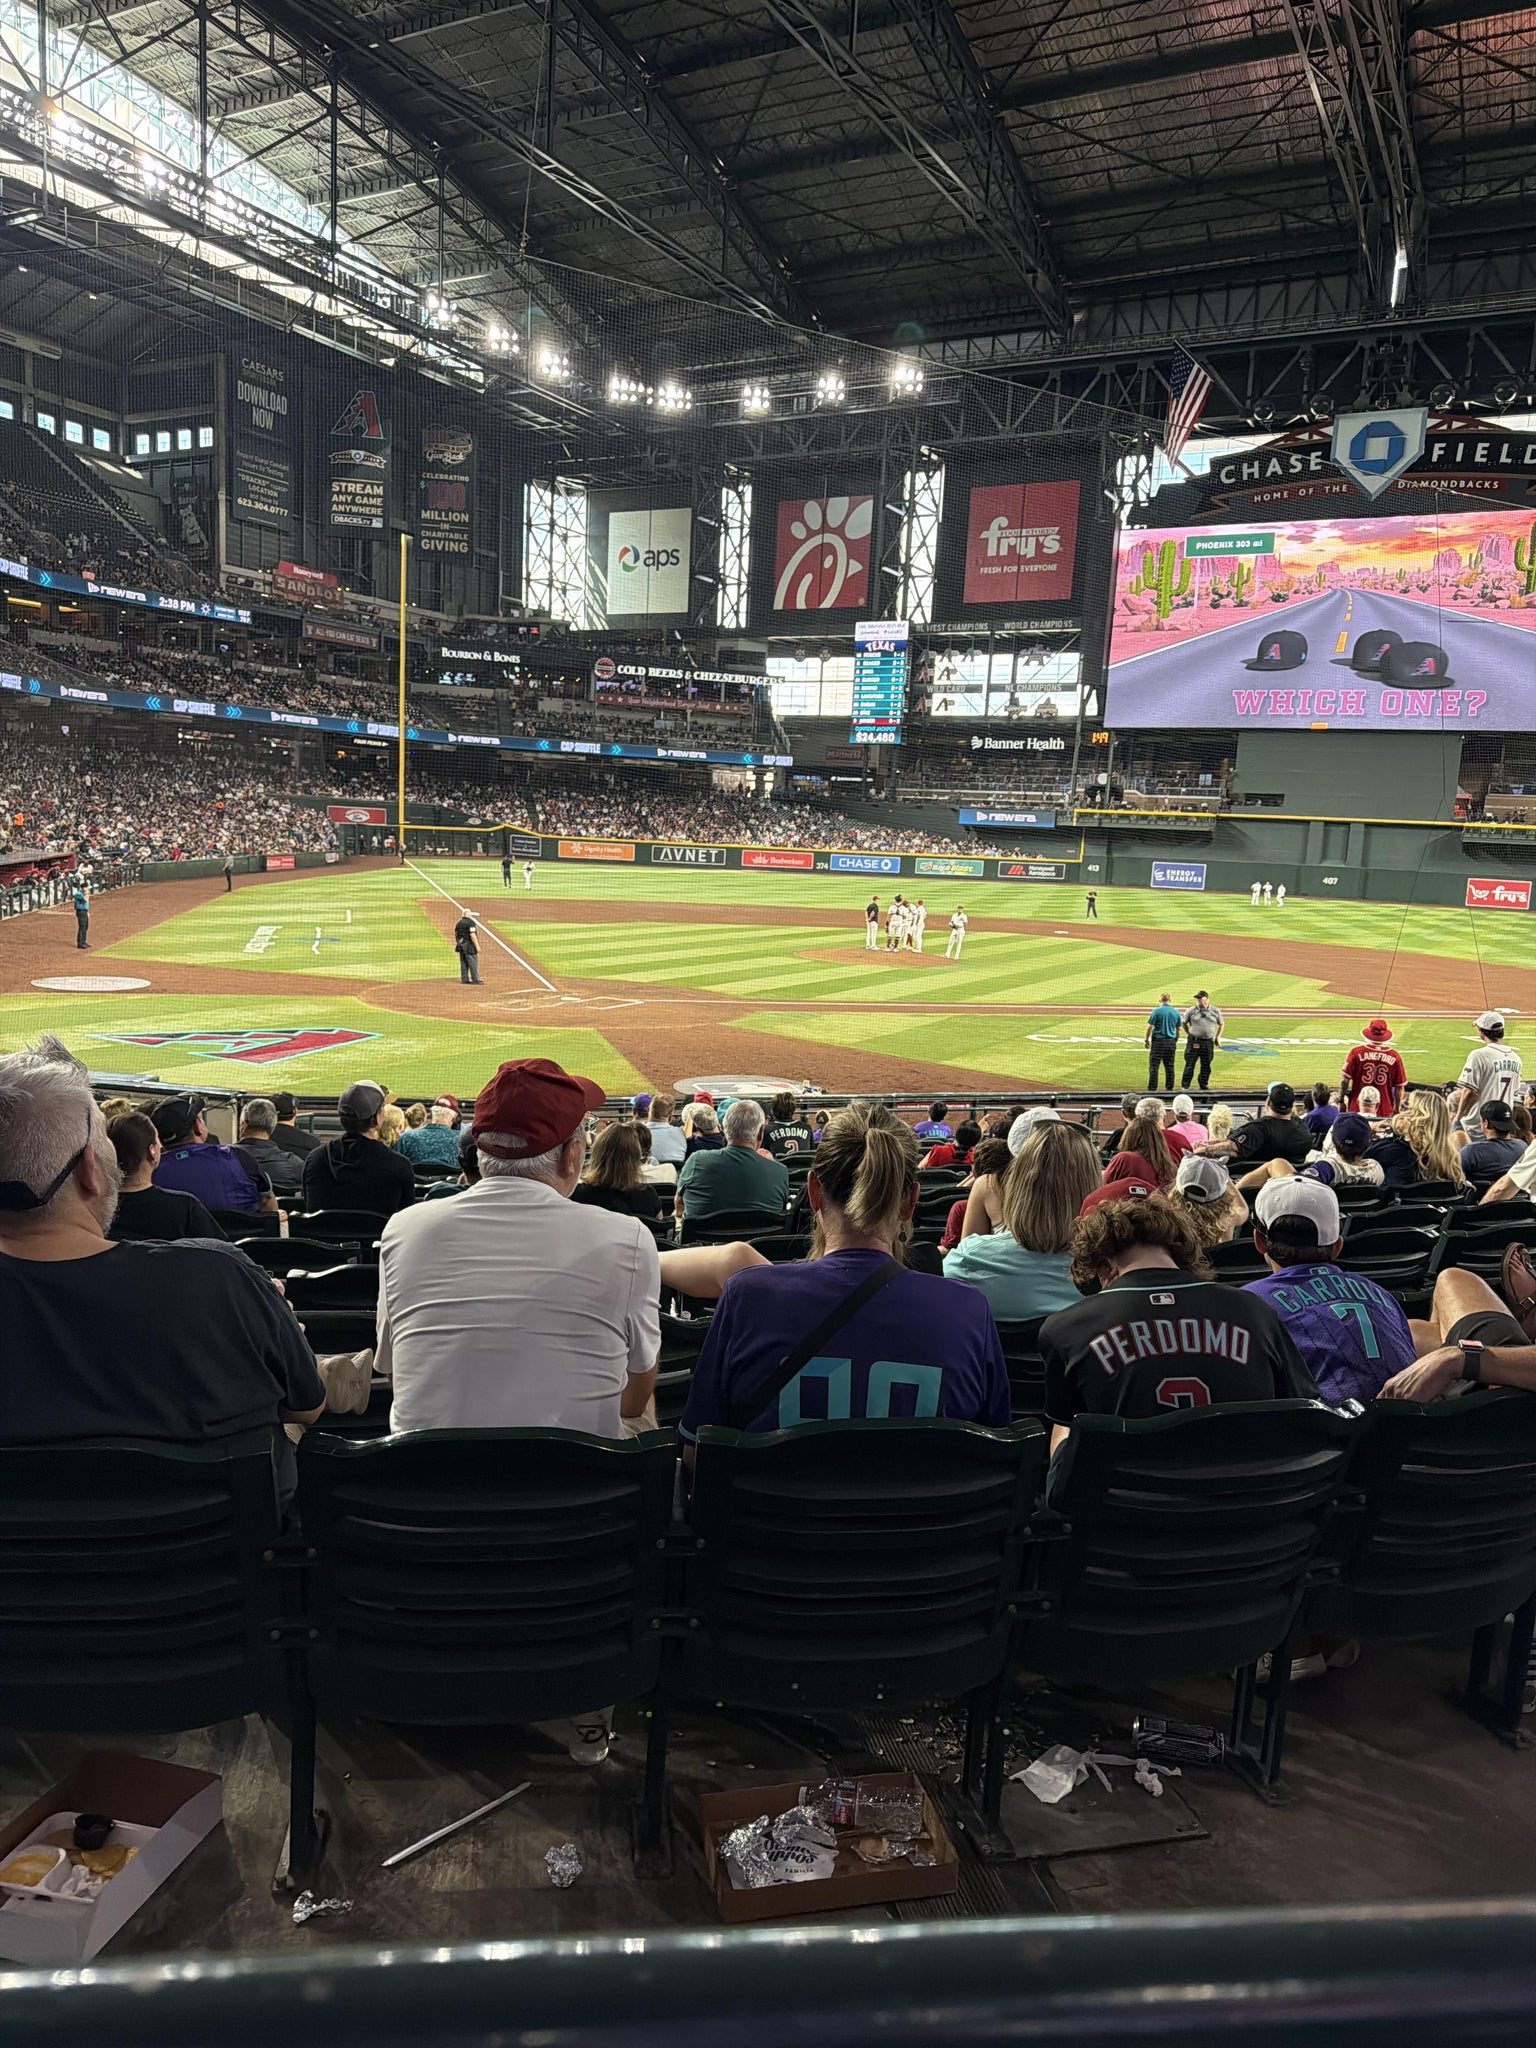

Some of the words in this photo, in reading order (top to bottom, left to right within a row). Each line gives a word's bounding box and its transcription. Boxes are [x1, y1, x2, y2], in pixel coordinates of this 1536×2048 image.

[241, 358, 284, 382] CAESARS
[238, 380, 288, 415] DOWNLOAD
[252, 406, 274, 430] NOW
[1220, 451, 1323, 484] CHASE
[422, 472, 470, 482] CELEBRATING
[248, 484, 278, 498] LOCATION
[332, 482, 384, 496] STREAM
[1254, 490, 1290, 503] HOME
[1299, 486, 1315, 498] OF
[1324, 484, 1349, 494] THE
[1398, 480, 1500, 490] DIAMONDBACKS
[237, 496, 288, 516] 623.304.0777
[332, 494, 352, 502] ANY
[356, 496, 384, 506] GAME
[332, 504, 384, 516] ANYWHERE
[421, 510, 469, 522] MILLION
[440, 522, 450, 530] IN
[1025, 528, 1057, 536] STORES
[421, 530, 469, 540] CHARITABLE
[980, 516, 1060, 558] fry's
[421, 539, 469, 553] GIVING
[1196, 540, 1233, 550] PHOENIX
[1236, 540, 1250, 548] 303
[643, 548, 680, 572] aps
[980, 566, 1002, 574] FRESH
[1003, 565, 1018, 573] FOR
[1020, 563, 1058, 573] EVERYONE
[276, 577, 343, 602] SANDLOT
[158, 596, 179, 610] 2:38
[180, 601, 196, 612] PM
[916, 624, 924, 632] NL
[947, 622, 989, 632] CHAMPIONS
[1004, 622, 1029, 630] WORLD
[1030, 620, 1074, 628] CHAMPIONS
[865, 640, 896, 652] TEXAS
[442, 647, 482, 660] BOURBON
[483, 650, 492, 662] &
[494, 652, 520, 664] BONES
[617, 664, 646, 676] COLD
[648, 666, 684, 680] BEERS
[684, 670, 692, 680] &
[693, 671, 786, 686] CHEESEBURGERS
[927, 685, 946, 694] WILD
[946, 685, 966, 693] CARD
[1005, 684, 1016, 692] NL
[1016, 684, 1062, 692] CHAMPIONS
[1232, 690, 1367, 716] WHICH
[1379, 690, 1488, 716] ONE?
[856, 731, 896, 743] $24,480
[984, 738, 1026, 750] Banner
[1027, 737, 1064, 750] Health
[584, 846, 604, 854] Dignity
[660, 848, 718, 863] AVNET
[770, 857, 804, 866] Budweiser
[816, 862, 828, 870] 374
[838, 858, 879, 870] CHASE
[1087, 864, 1100, 872] 413
[1322, 876, 1338, 886] 407
[1358, 1052, 1397, 1066] LANGFORD
[1362, 1063, 1390, 1086] 36
[1500, 1077, 1512, 1102] 7
[770, 1128, 808, 1141] PERDOMO
[1330, 1302, 1380, 1359] 7
[1089, 1318, 1250, 1376] PERDOMO
